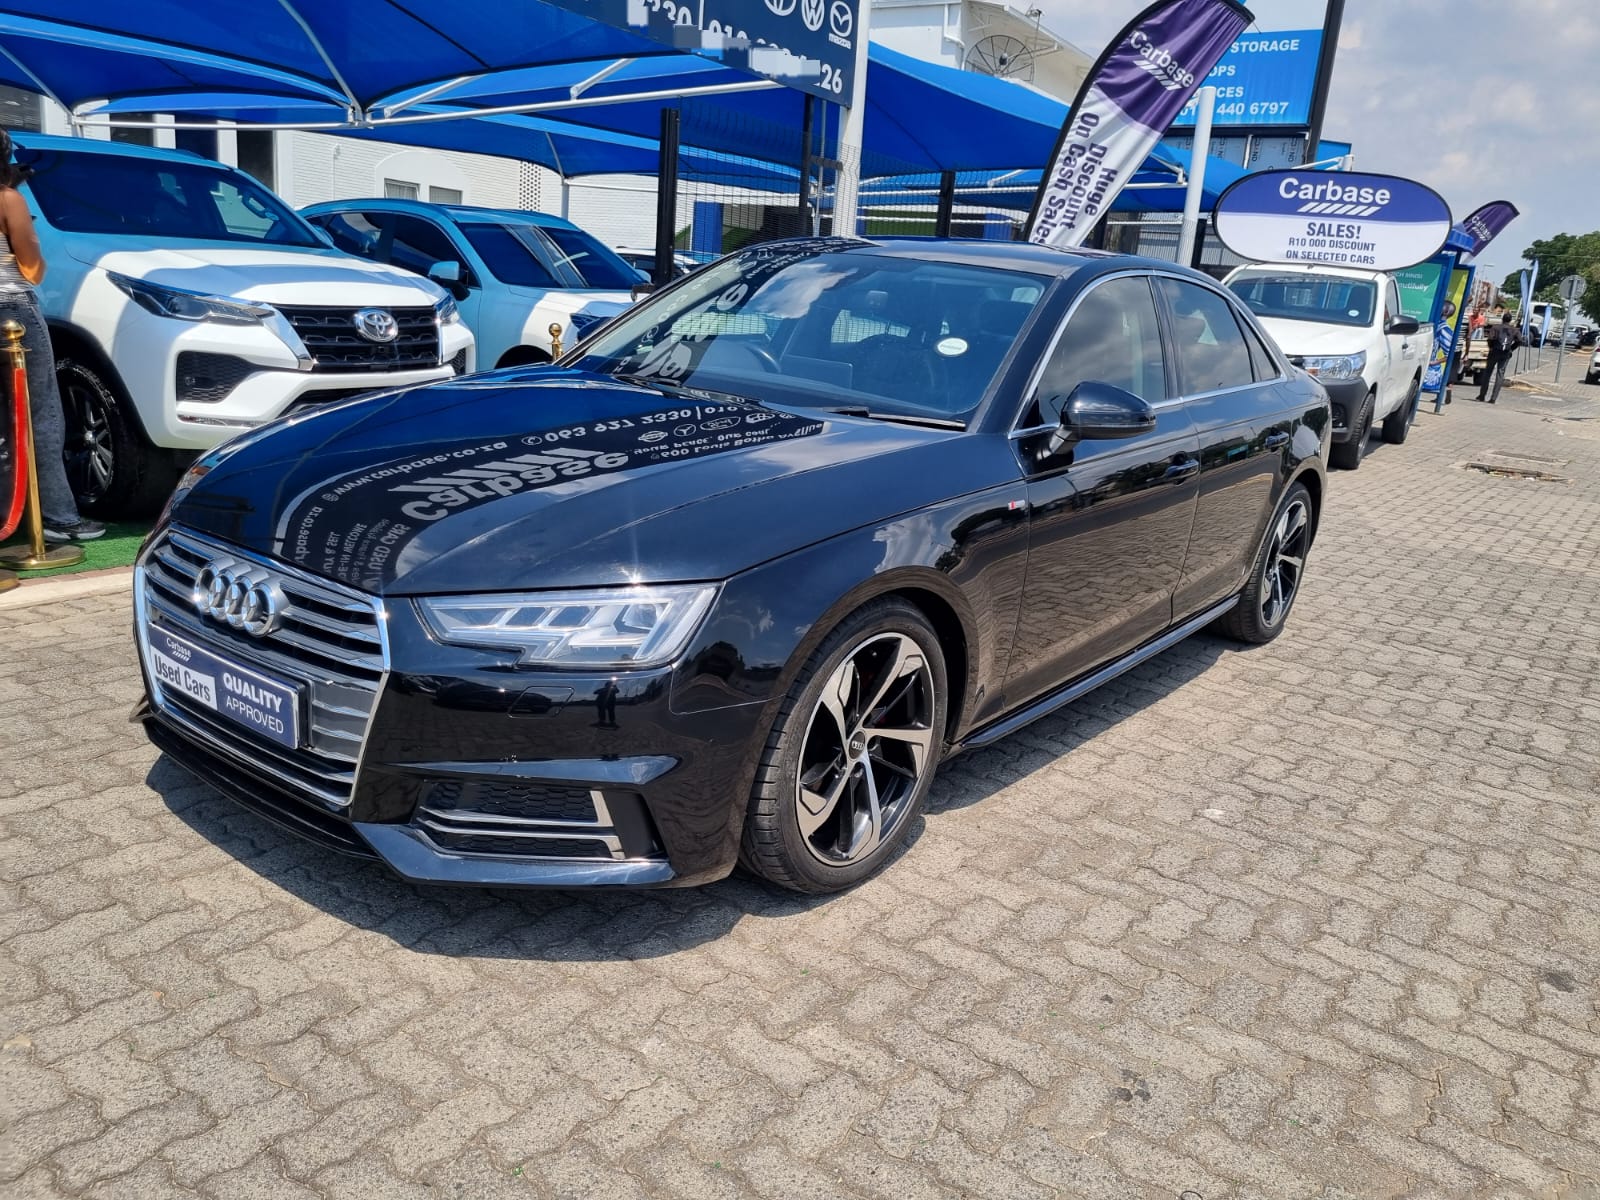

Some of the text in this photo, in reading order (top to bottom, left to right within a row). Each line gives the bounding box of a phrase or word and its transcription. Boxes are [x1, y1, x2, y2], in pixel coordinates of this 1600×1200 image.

[1130, 30, 1195, 88] Carbase
[1231, 39, 1300, 54] STORAGE
[1216, 103, 1246, 116] 440
[1250, 102, 1289, 116] 6797
[1075, 112, 1100, 139] On
[1054, 143, 1086, 191] Cash
[1060, 142, 1108, 230] Discount
[1085, 169, 1119, 217] Huge
[1278, 177, 1391, 206] Carbase
[1288, 237, 1376, 252] R10 000 DISCOUNT
[1306, 221, 1362, 239] SALES!
[1286, 249, 1376, 265] ON SELECTED CARS
[165, 637, 192, 658] Carbase
[154, 652, 212, 702] Used Cars
[222, 671, 283, 713] QUALITY
[225, 691, 284, 735] APPROVED
